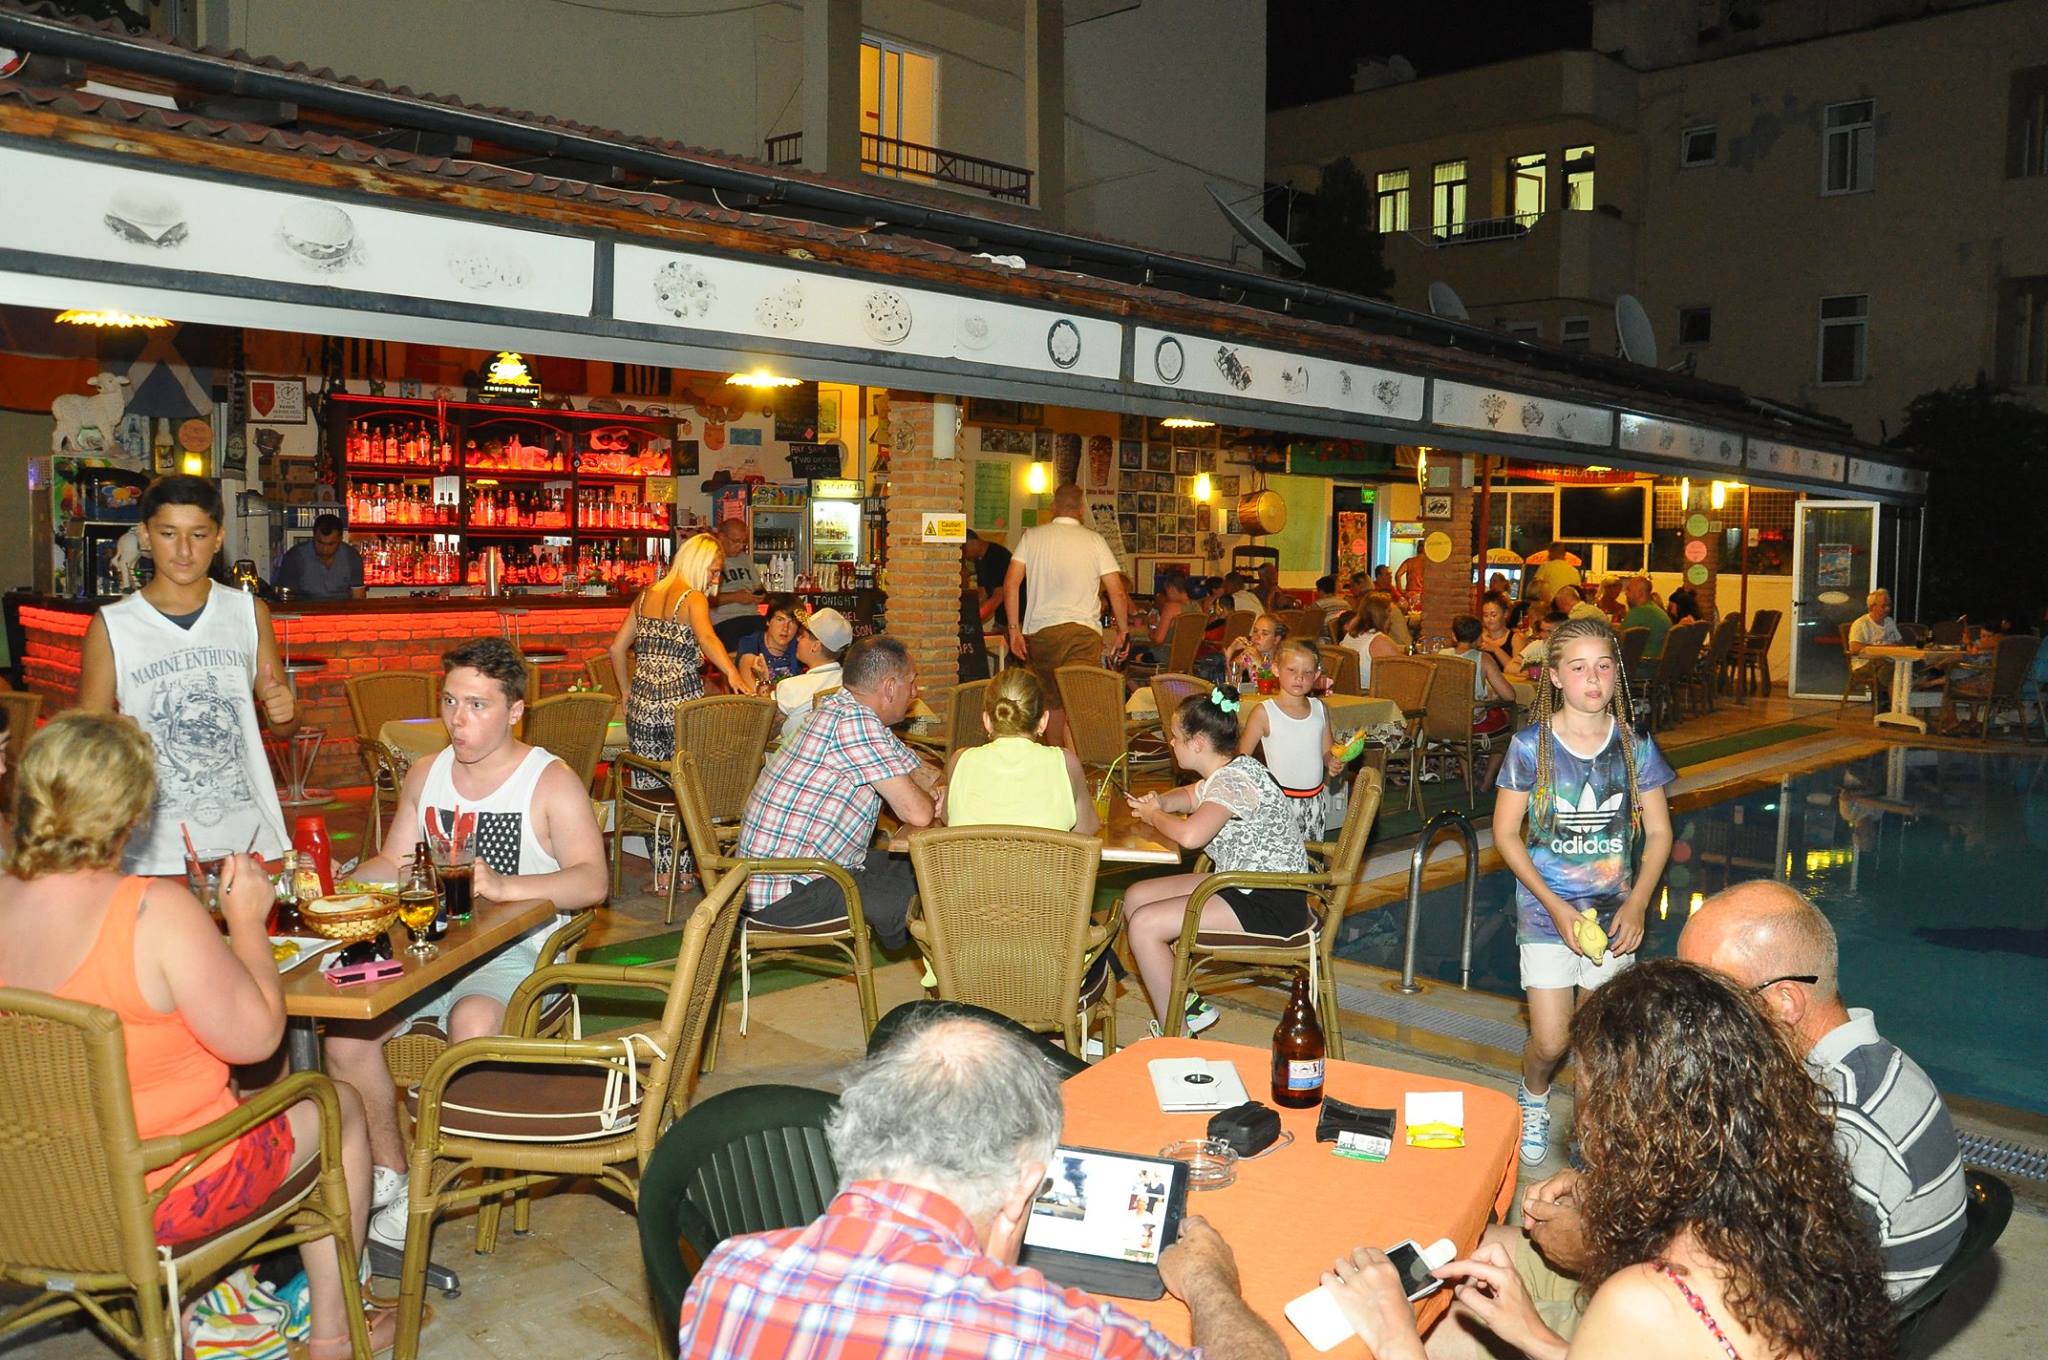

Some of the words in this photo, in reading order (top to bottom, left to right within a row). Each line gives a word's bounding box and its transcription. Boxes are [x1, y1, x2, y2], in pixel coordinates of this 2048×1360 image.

[941, 520, 961, 528] Caution
[813, 595, 859, 607] TONIGHT
[130, 656, 184, 688] MARINE
[185, 648, 249, 671] ENTHUSIA
[1550, 835, 1624, 855] adidas
